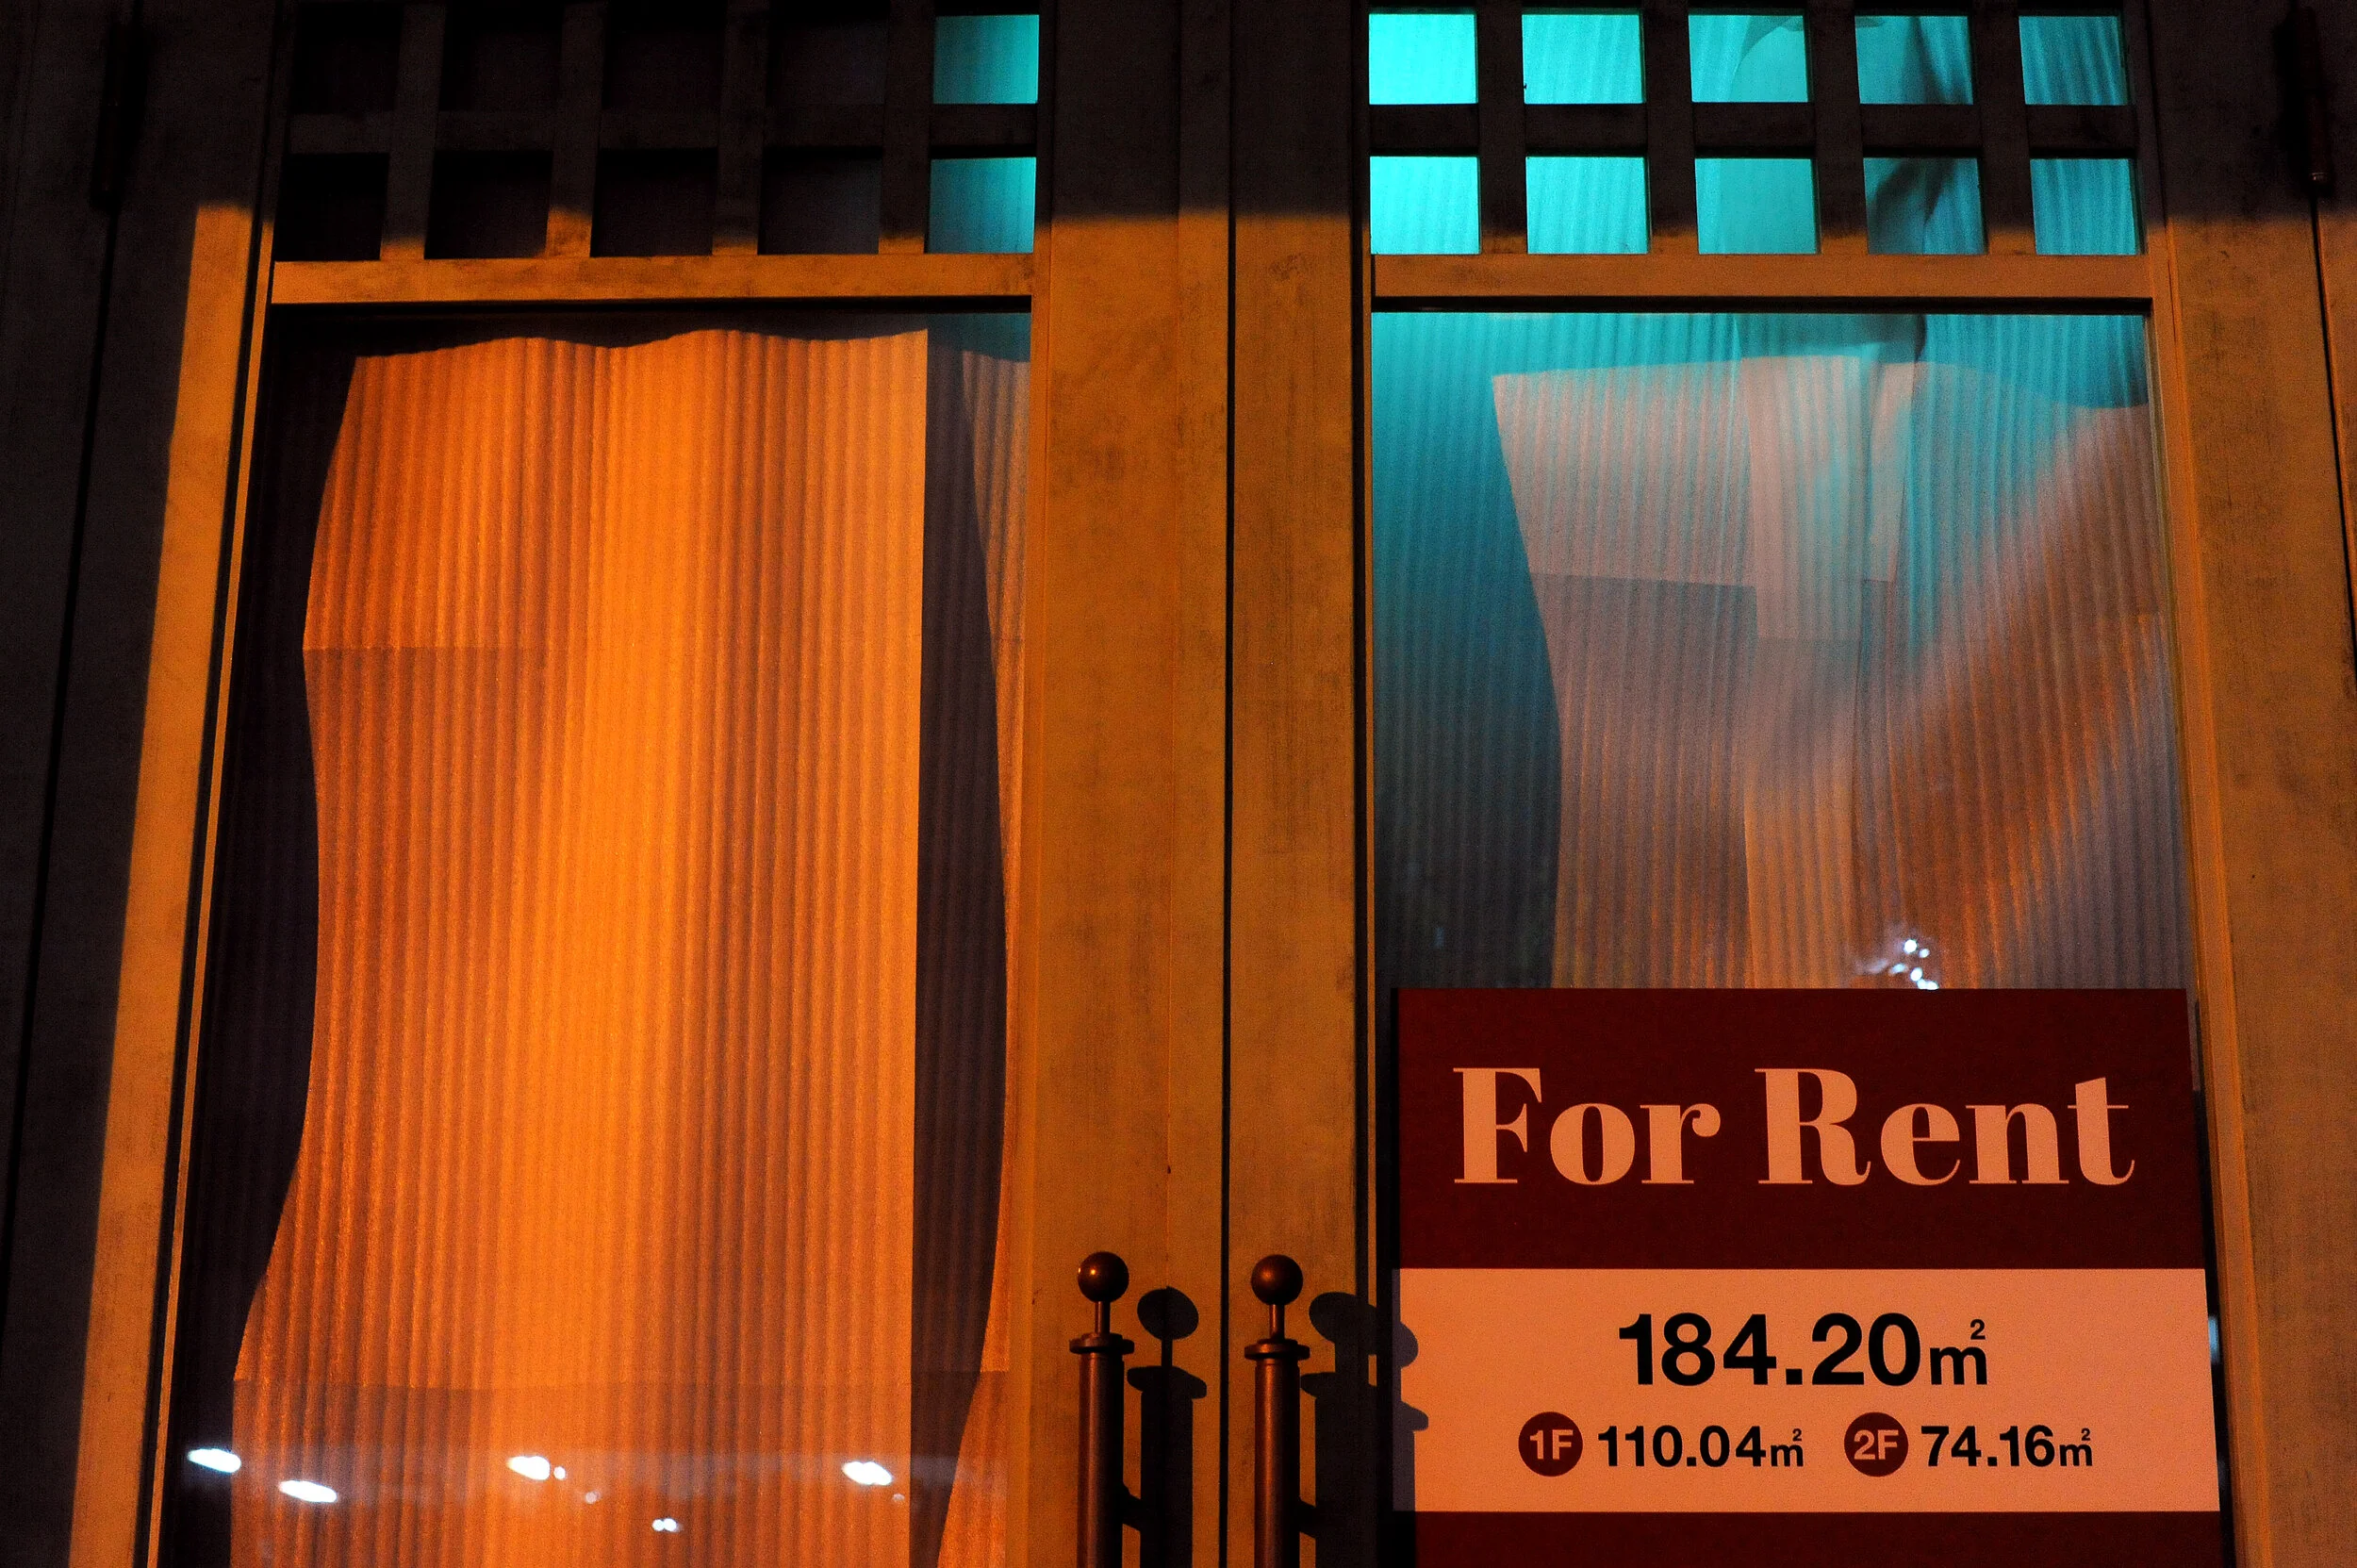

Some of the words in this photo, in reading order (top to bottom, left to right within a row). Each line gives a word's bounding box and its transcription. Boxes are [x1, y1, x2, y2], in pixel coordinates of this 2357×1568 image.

[1453, 1066, 1721, 1185] For
[1755, 1067, 2135, 1186] Rent
[1528, 1428, 1574, 1461] 1F
[1853, 1428, 1900, 1461] 2F
